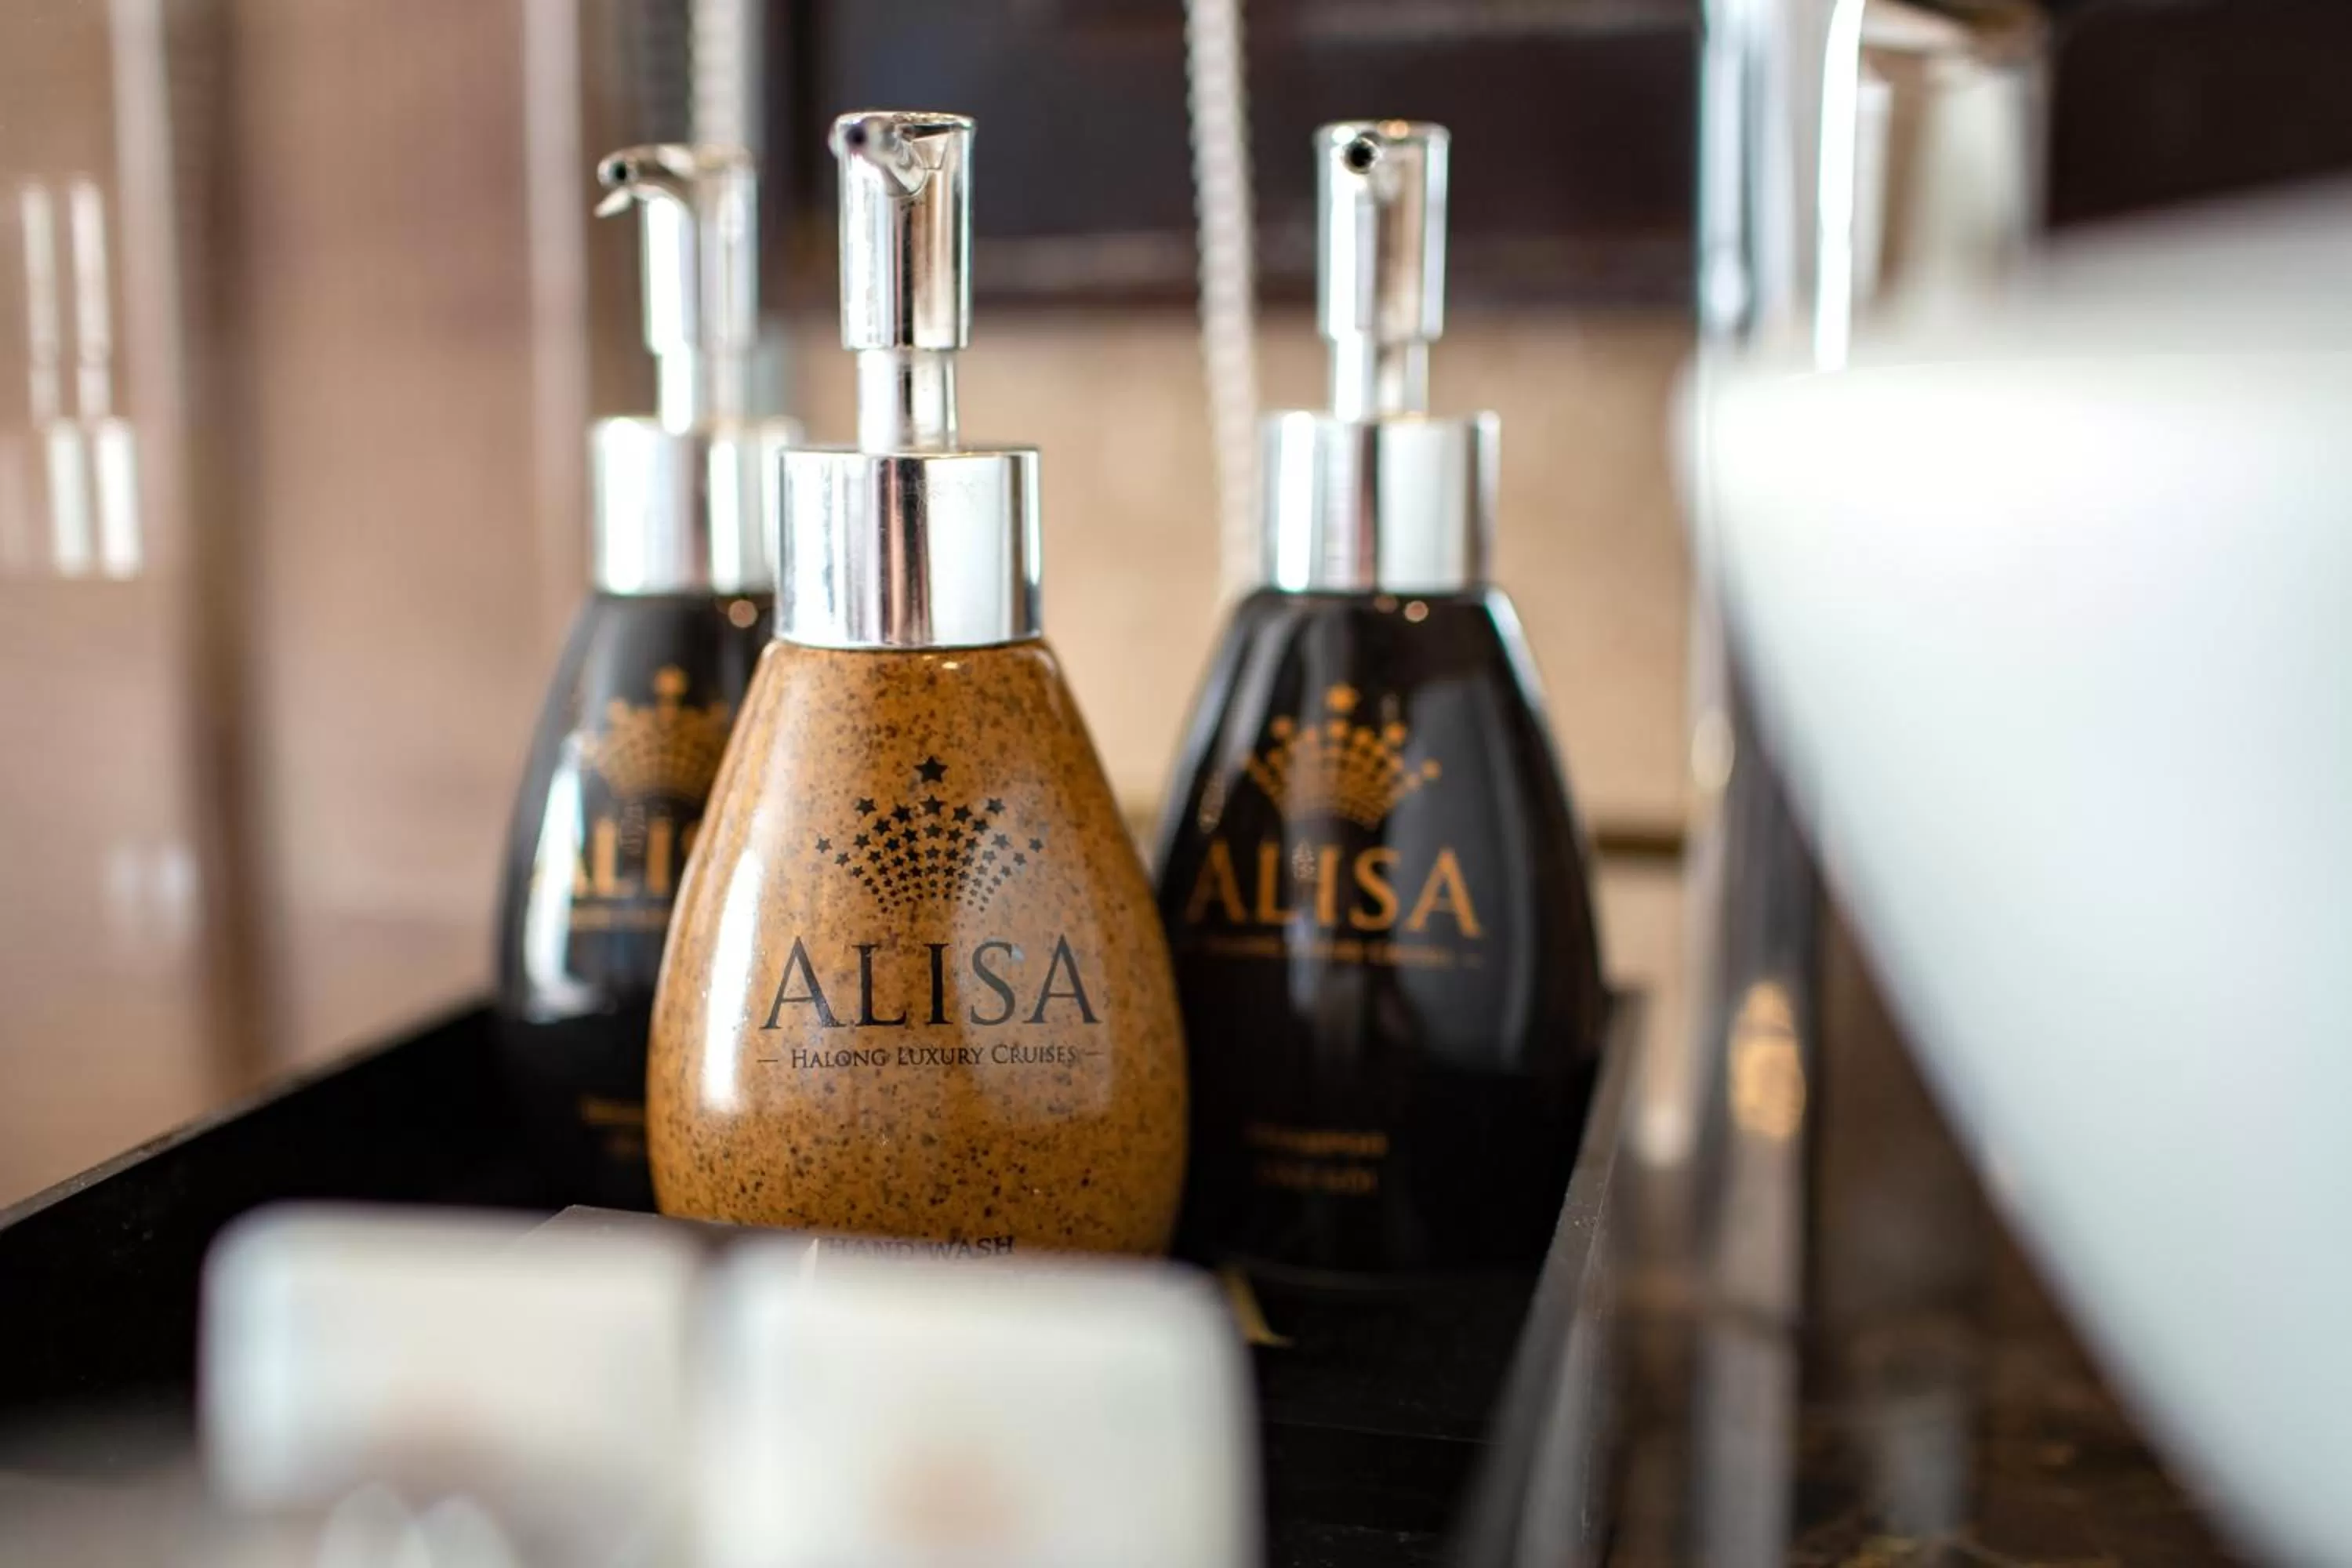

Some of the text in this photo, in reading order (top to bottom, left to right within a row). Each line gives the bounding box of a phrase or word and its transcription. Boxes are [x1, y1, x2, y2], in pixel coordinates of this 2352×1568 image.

[1185, 840, 1482, 938] ALISA
[759, 935, 1102, 1030] ALISA
[791, 1044, 1077, 1068] HALONG LUXURY CRUISES
[826, 1236, 1015, 1258] HAND WASH
